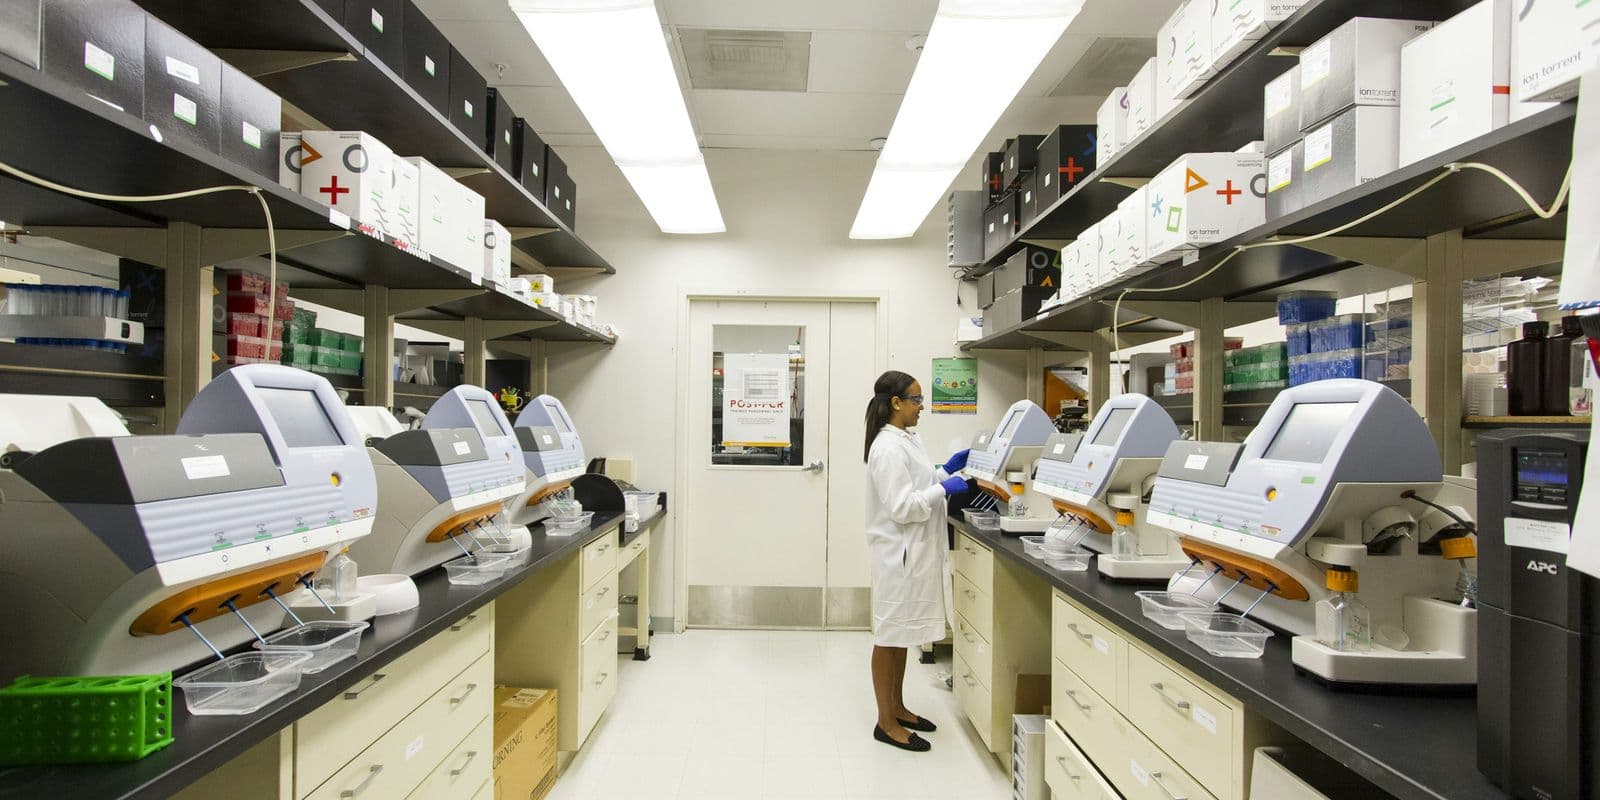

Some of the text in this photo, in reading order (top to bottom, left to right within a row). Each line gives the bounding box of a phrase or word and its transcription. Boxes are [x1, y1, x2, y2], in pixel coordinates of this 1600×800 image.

[1523, 51, 1581, 86] ion torrent
[1527, 560, 1558, 575] APC
